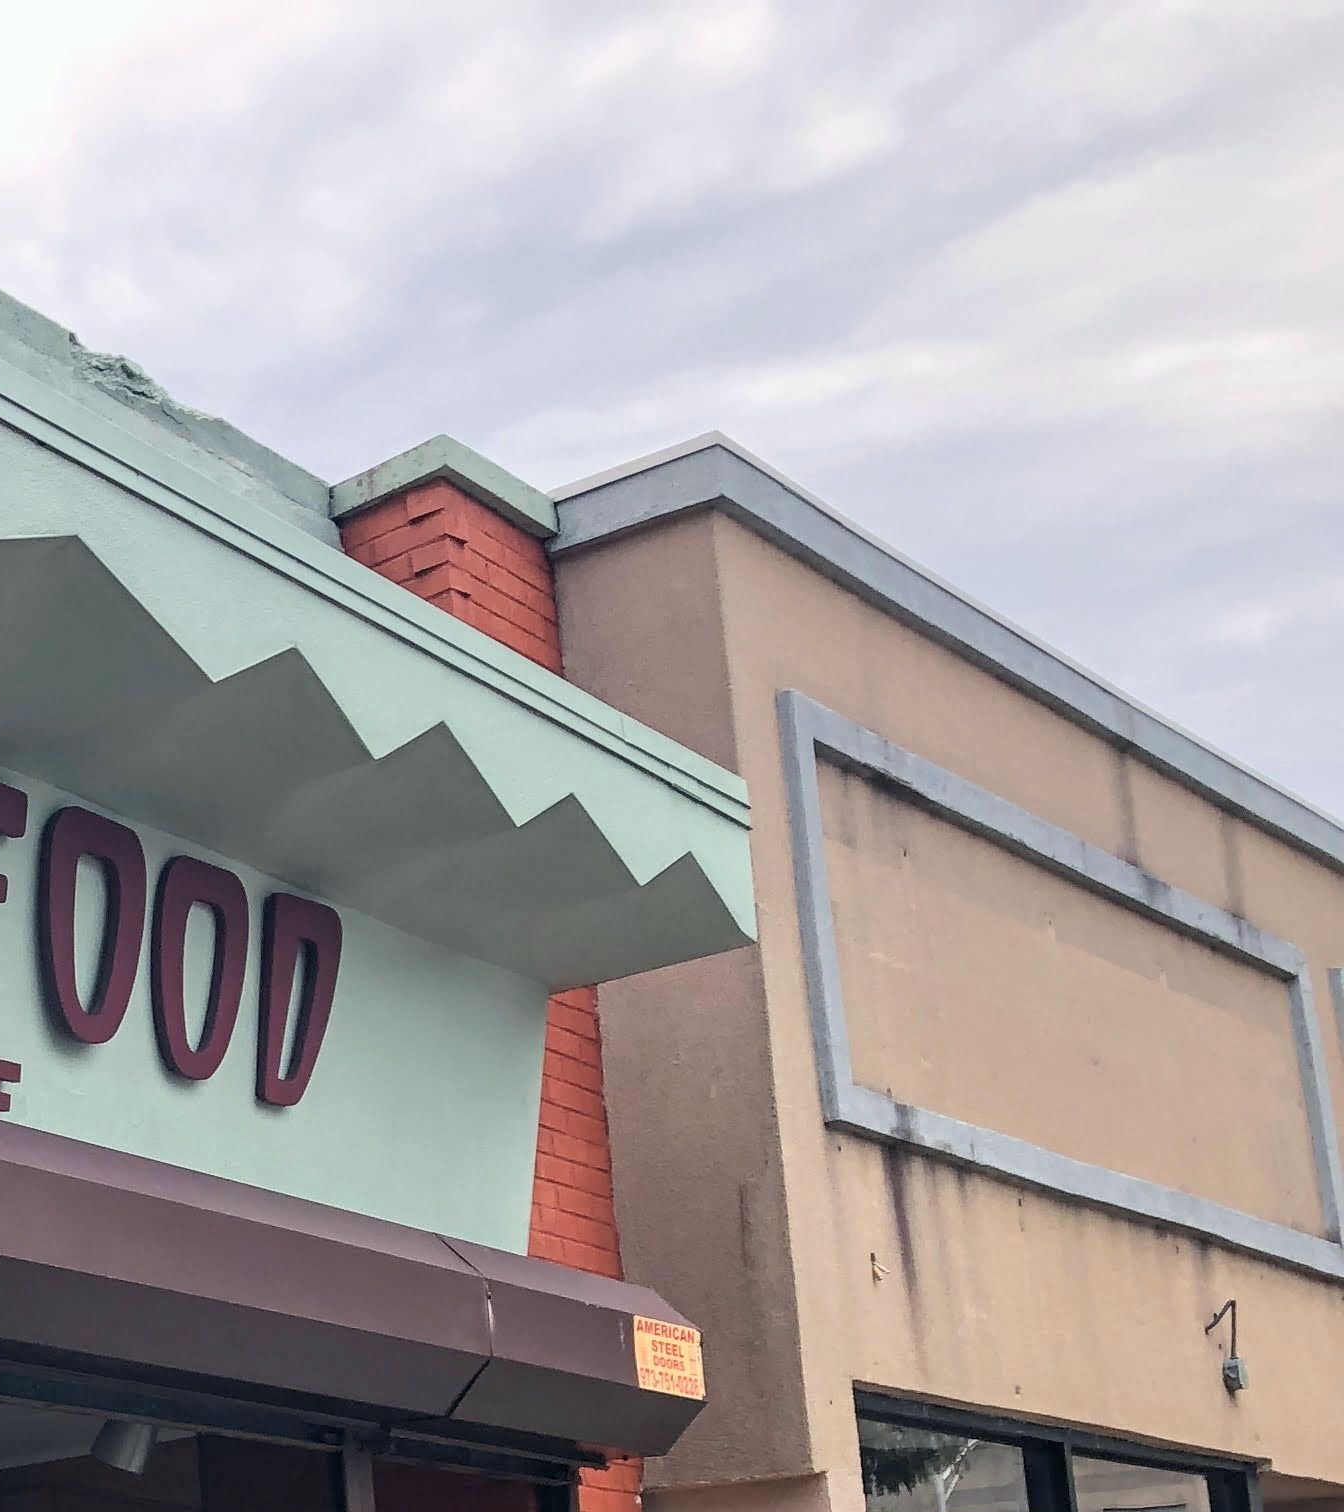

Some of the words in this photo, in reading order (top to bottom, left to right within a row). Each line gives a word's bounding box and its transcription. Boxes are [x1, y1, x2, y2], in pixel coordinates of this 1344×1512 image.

[637, 1319, 695, 1344] AMERICAN
[652, 1340, 684, 1358] STEEL
[653, 1355, 685, 1371] DOORS
